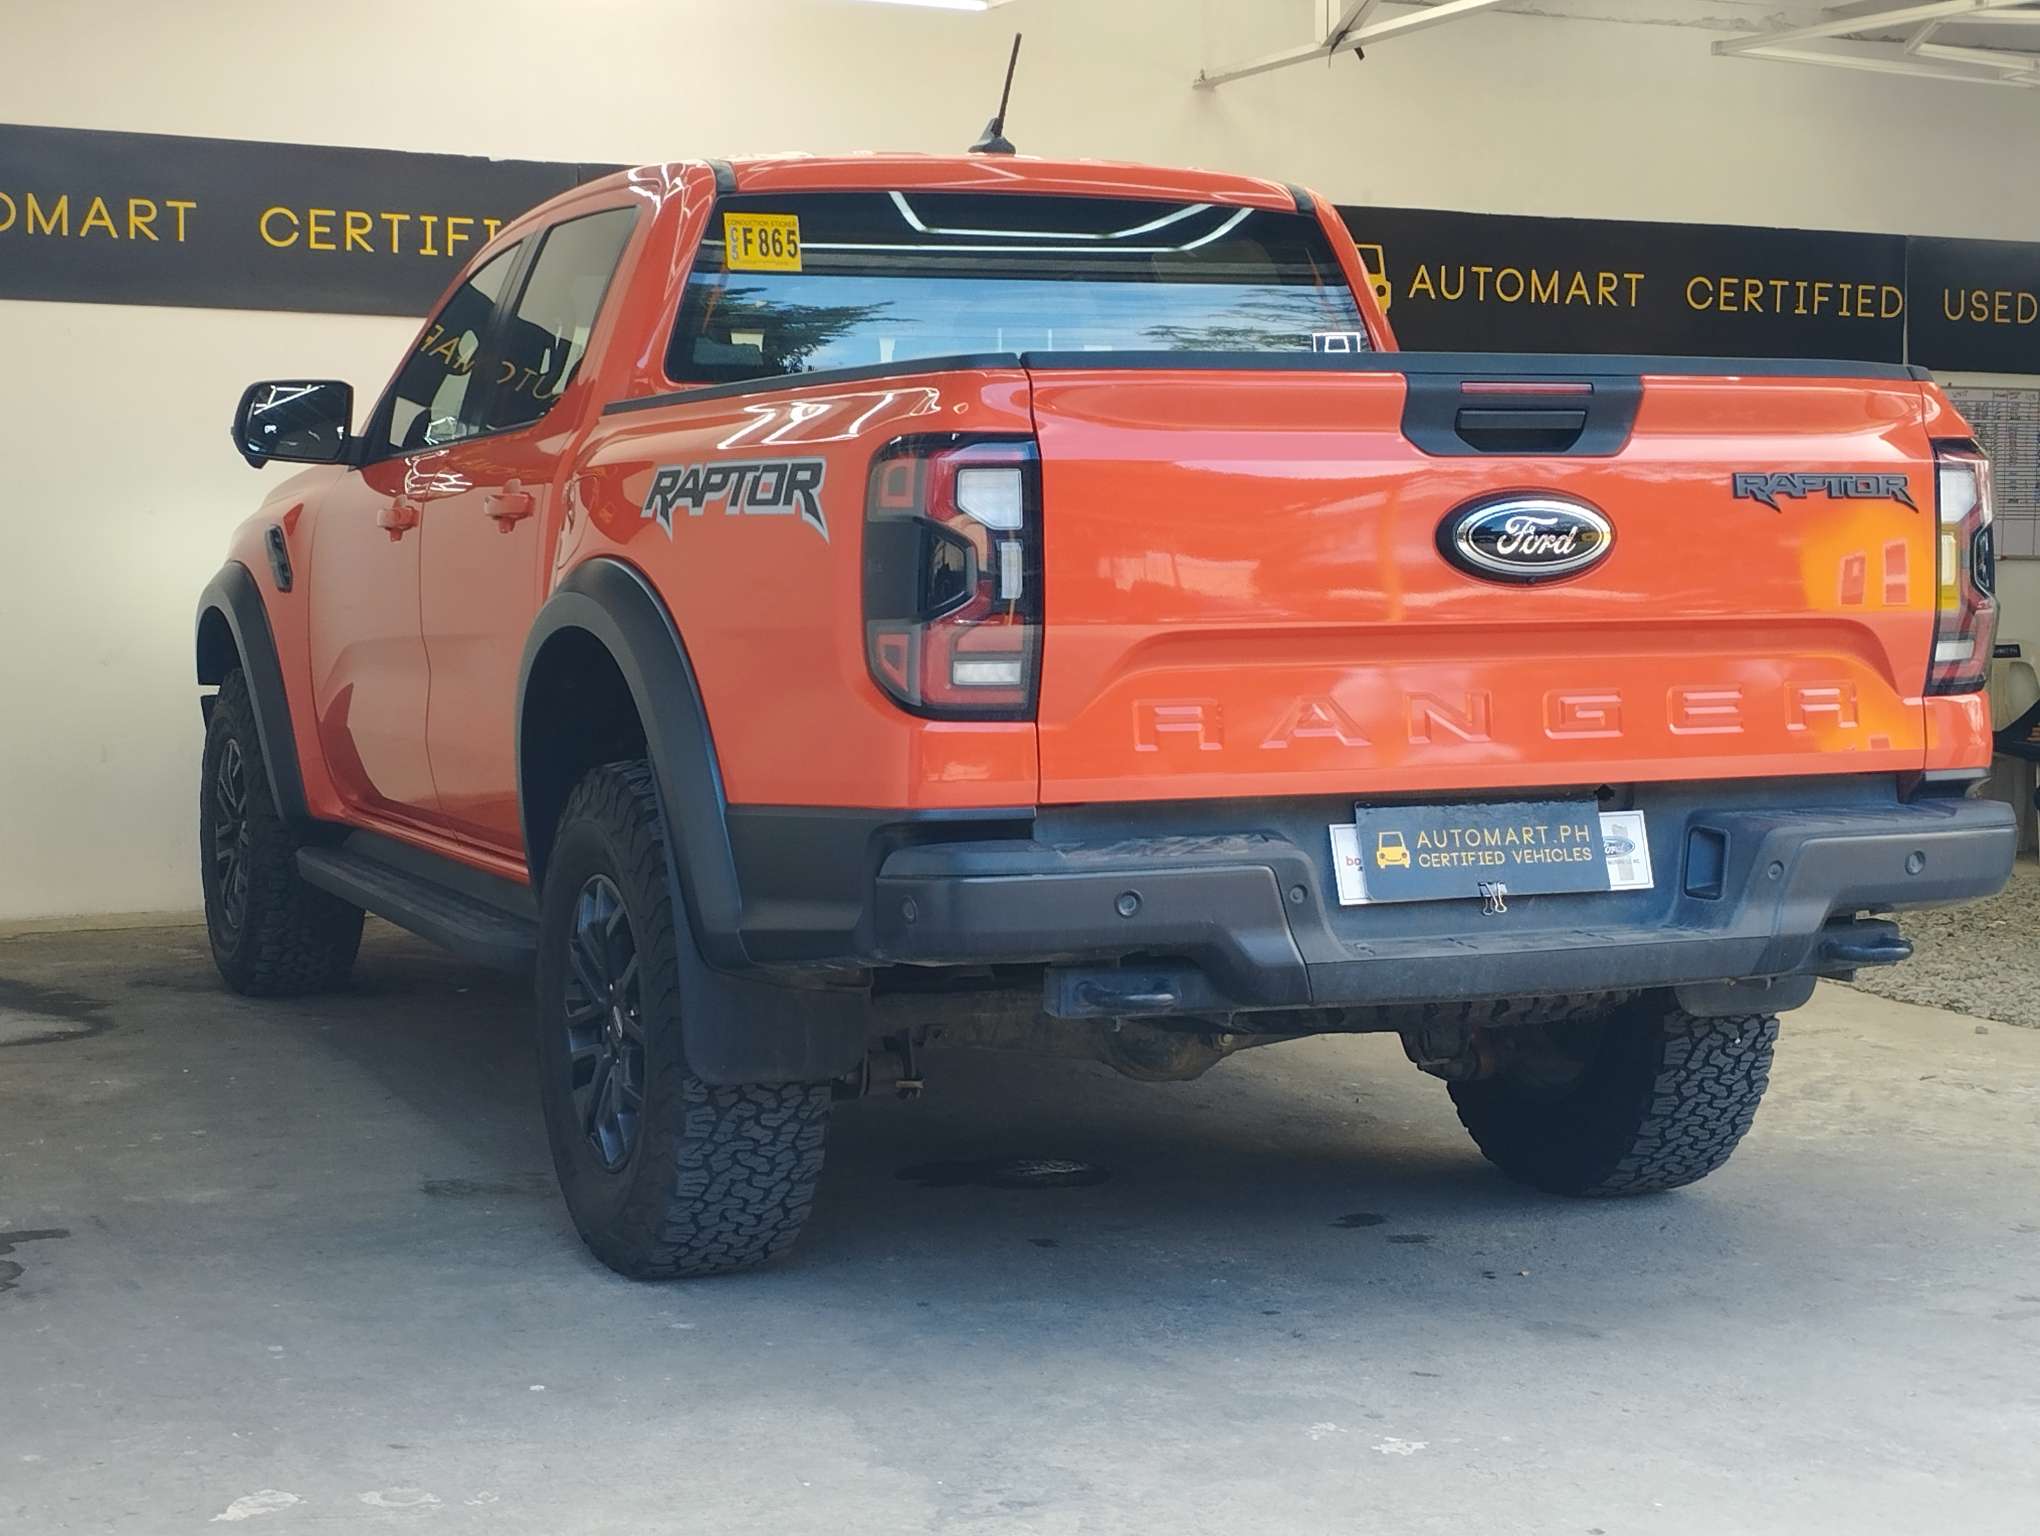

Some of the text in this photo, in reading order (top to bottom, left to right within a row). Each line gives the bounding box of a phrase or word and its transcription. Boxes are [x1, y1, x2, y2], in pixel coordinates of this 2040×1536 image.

[1408, 264, 2038, 325] AUTOMART CERTIFIED USED
[640, 456, 829, 544] RAPTOR
[1732, 472, 1919, 514] RAPTOR
[1497, 516, 1577, 554] Ford
[1131, 682, 1858, 752] RANGER
[1416, 825, 1590, 849] AUTOMART.PH
[1418, 847, 1593, 868] CERTIFIED VEHICLES
